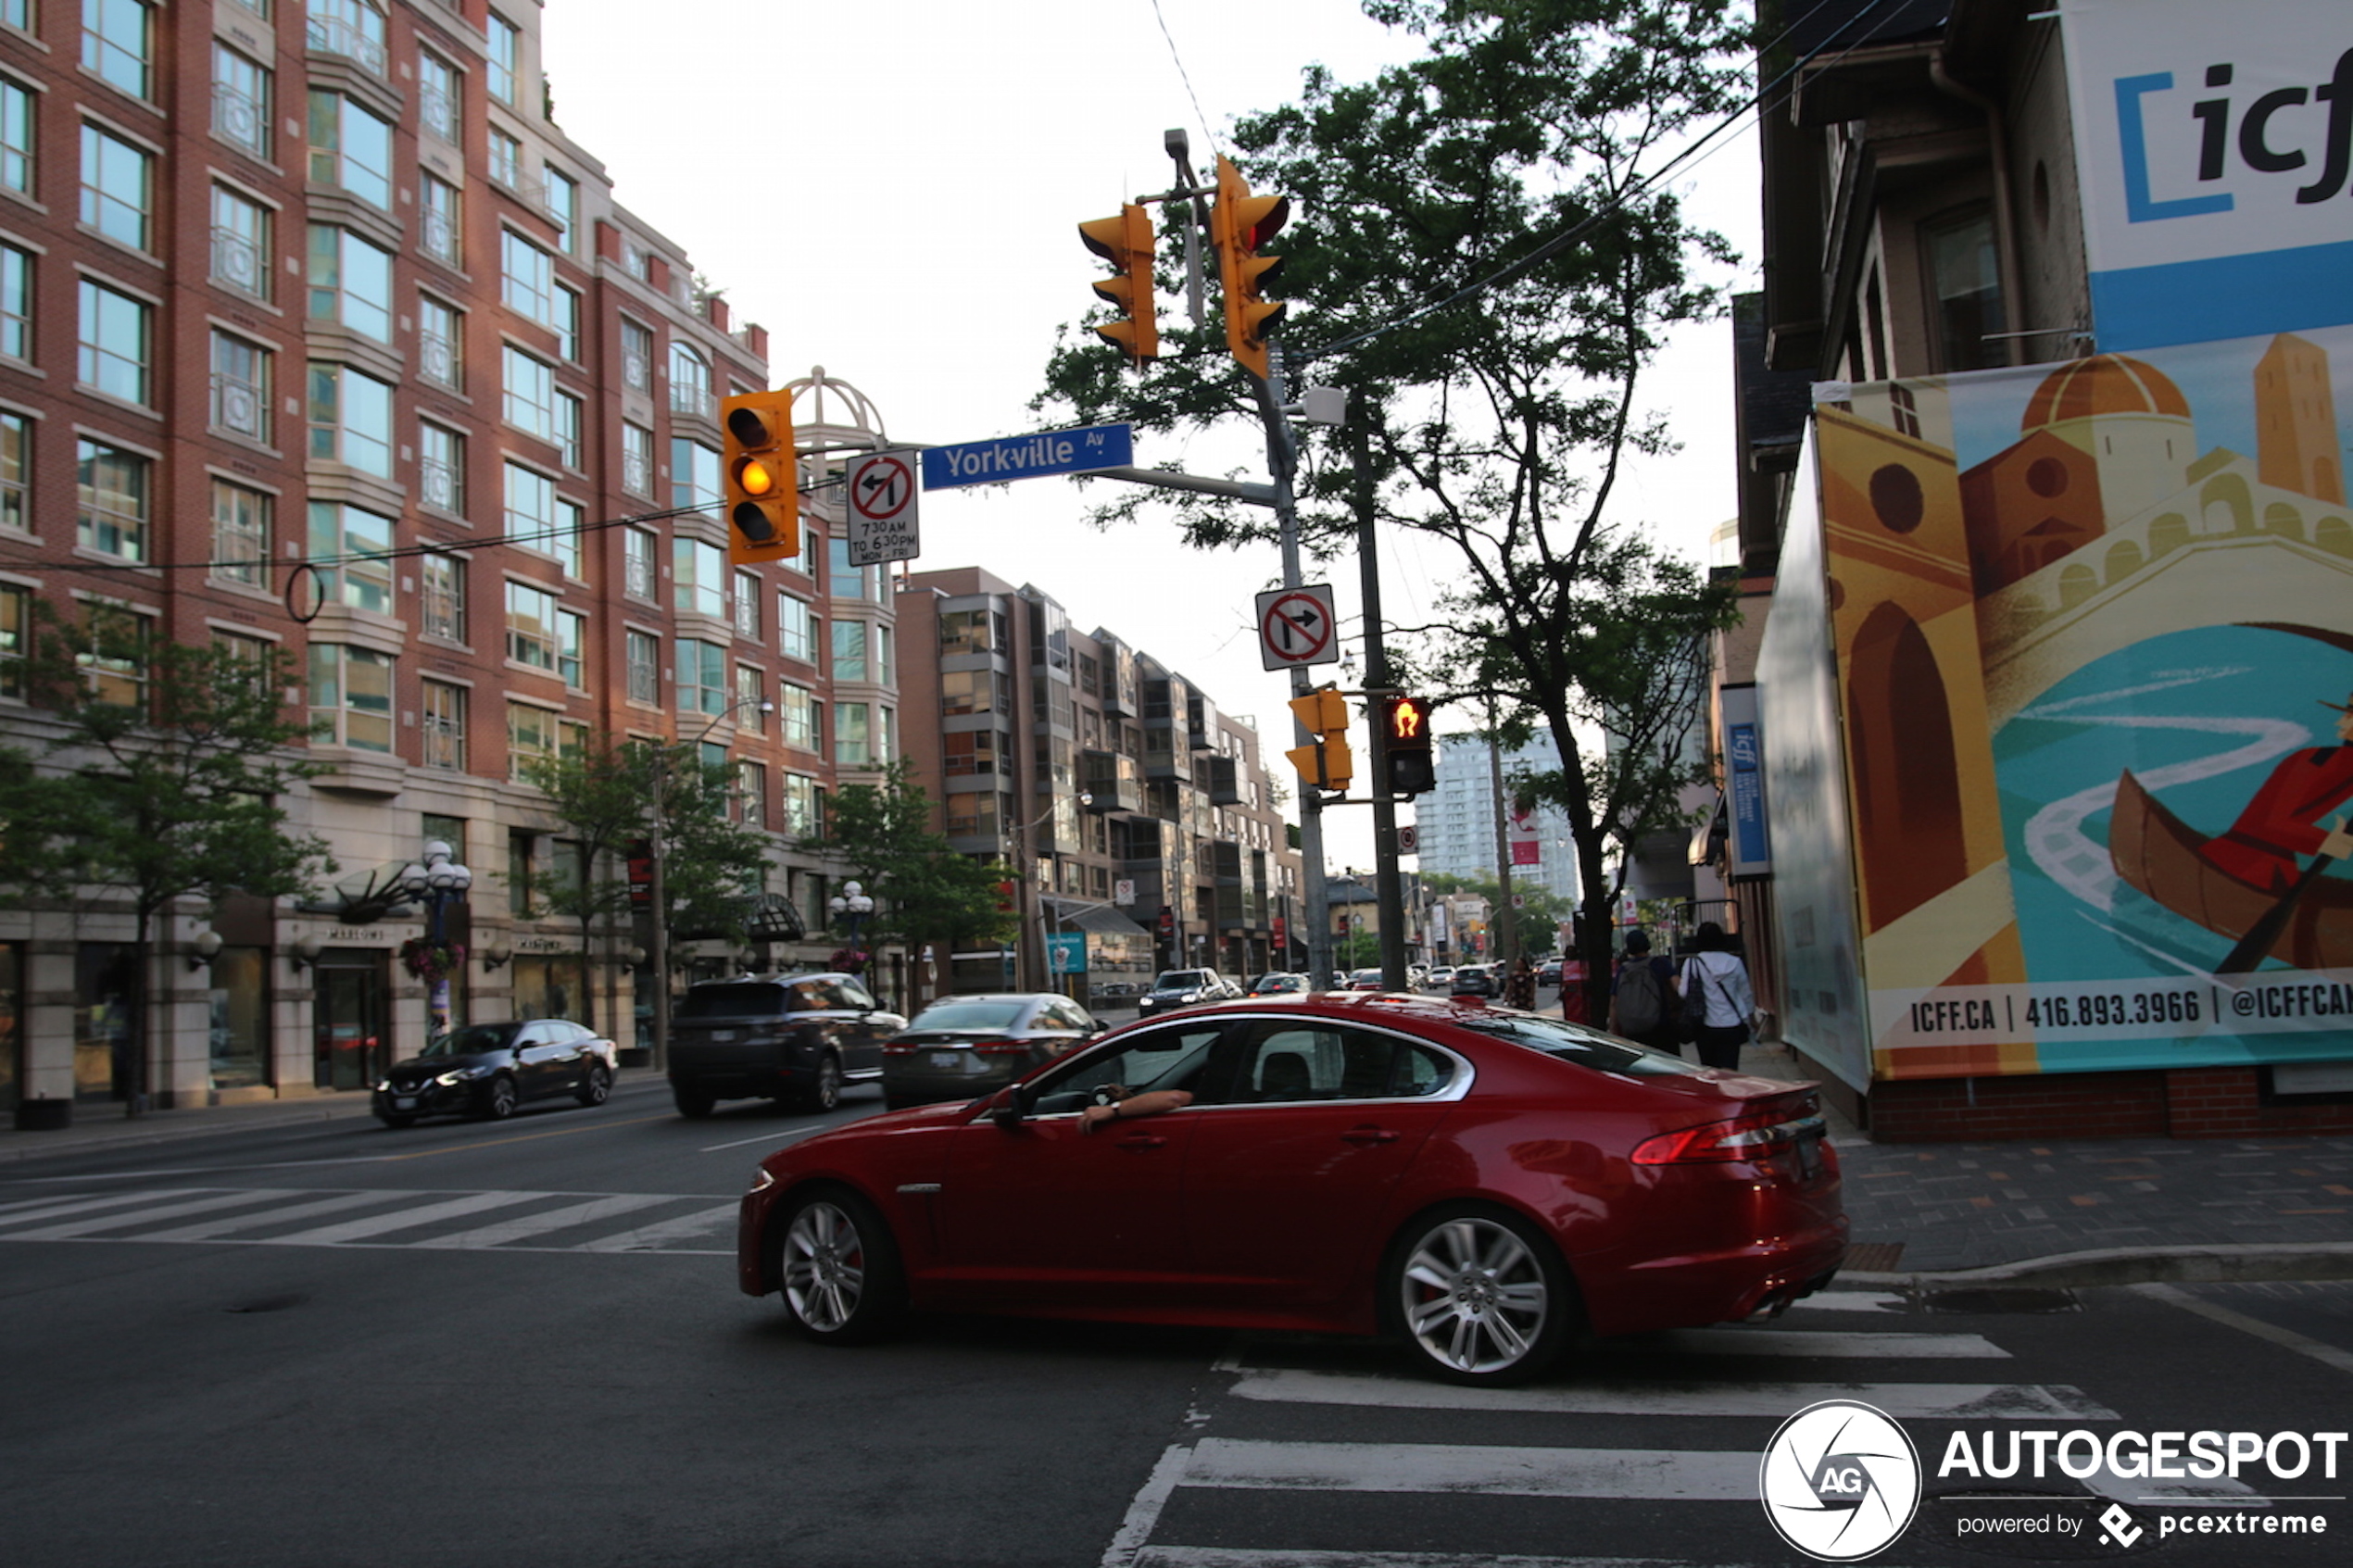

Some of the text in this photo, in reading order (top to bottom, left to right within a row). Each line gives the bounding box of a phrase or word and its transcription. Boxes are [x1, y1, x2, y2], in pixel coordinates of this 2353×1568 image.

[2193, 45, 2353, 205] icf
[945, 436, 1075, 477] Yorkville
[853, 541, 867, 552] TO
[862, 551, 882, 561] MON
[893, 548, 908, 557] FRI
[1732, 734, 1756, 764] icff
[1911, 999, 1995, 1033] ICFF.CA
[2026, 990, 2200, 1028] 416.893.3966
